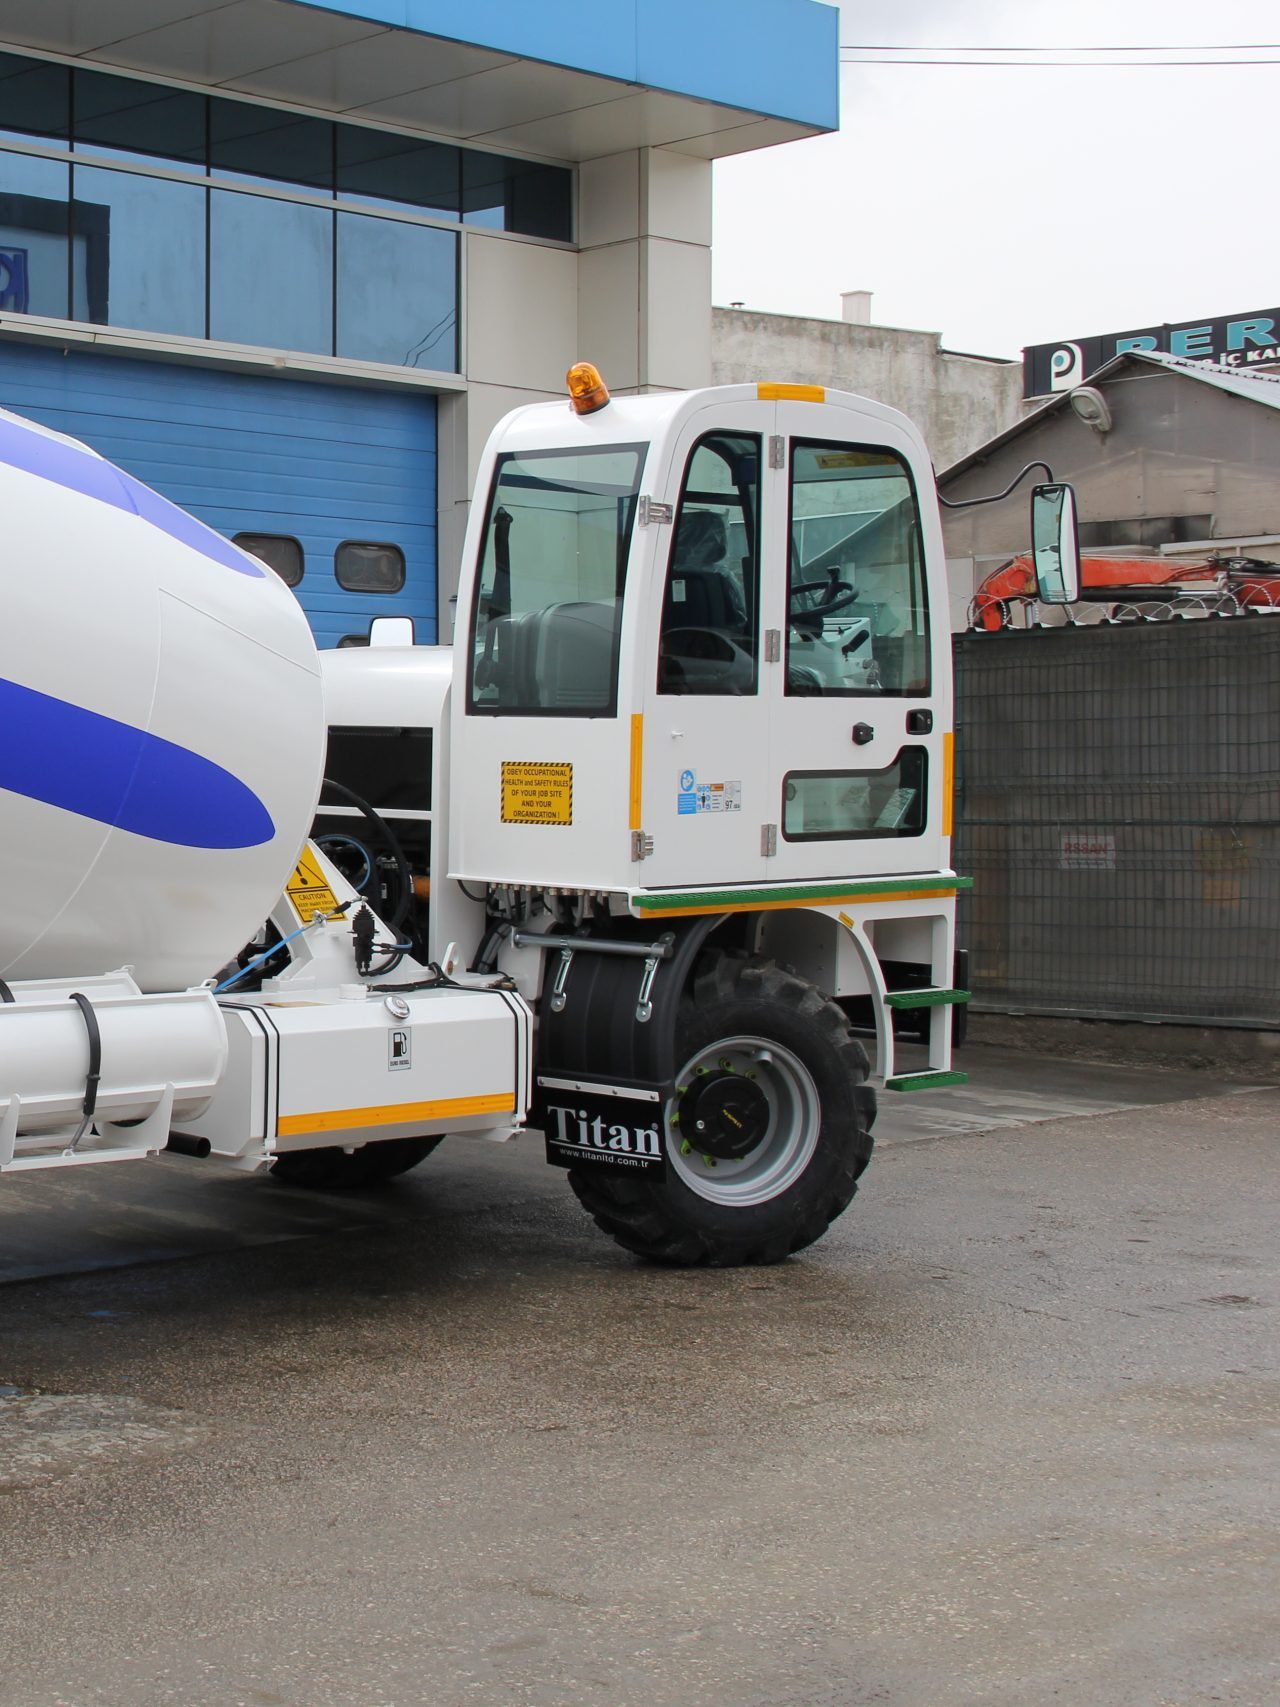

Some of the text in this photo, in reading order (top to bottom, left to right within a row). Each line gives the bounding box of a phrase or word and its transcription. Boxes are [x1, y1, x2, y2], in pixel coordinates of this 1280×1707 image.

[1246, 347, 1280, 362] KA
[538, 790, 548, 798] JOB
[547, 1105, 662, 1156] Titan
[560, 1148, 649, 1168] www.titanltd.com.tr
